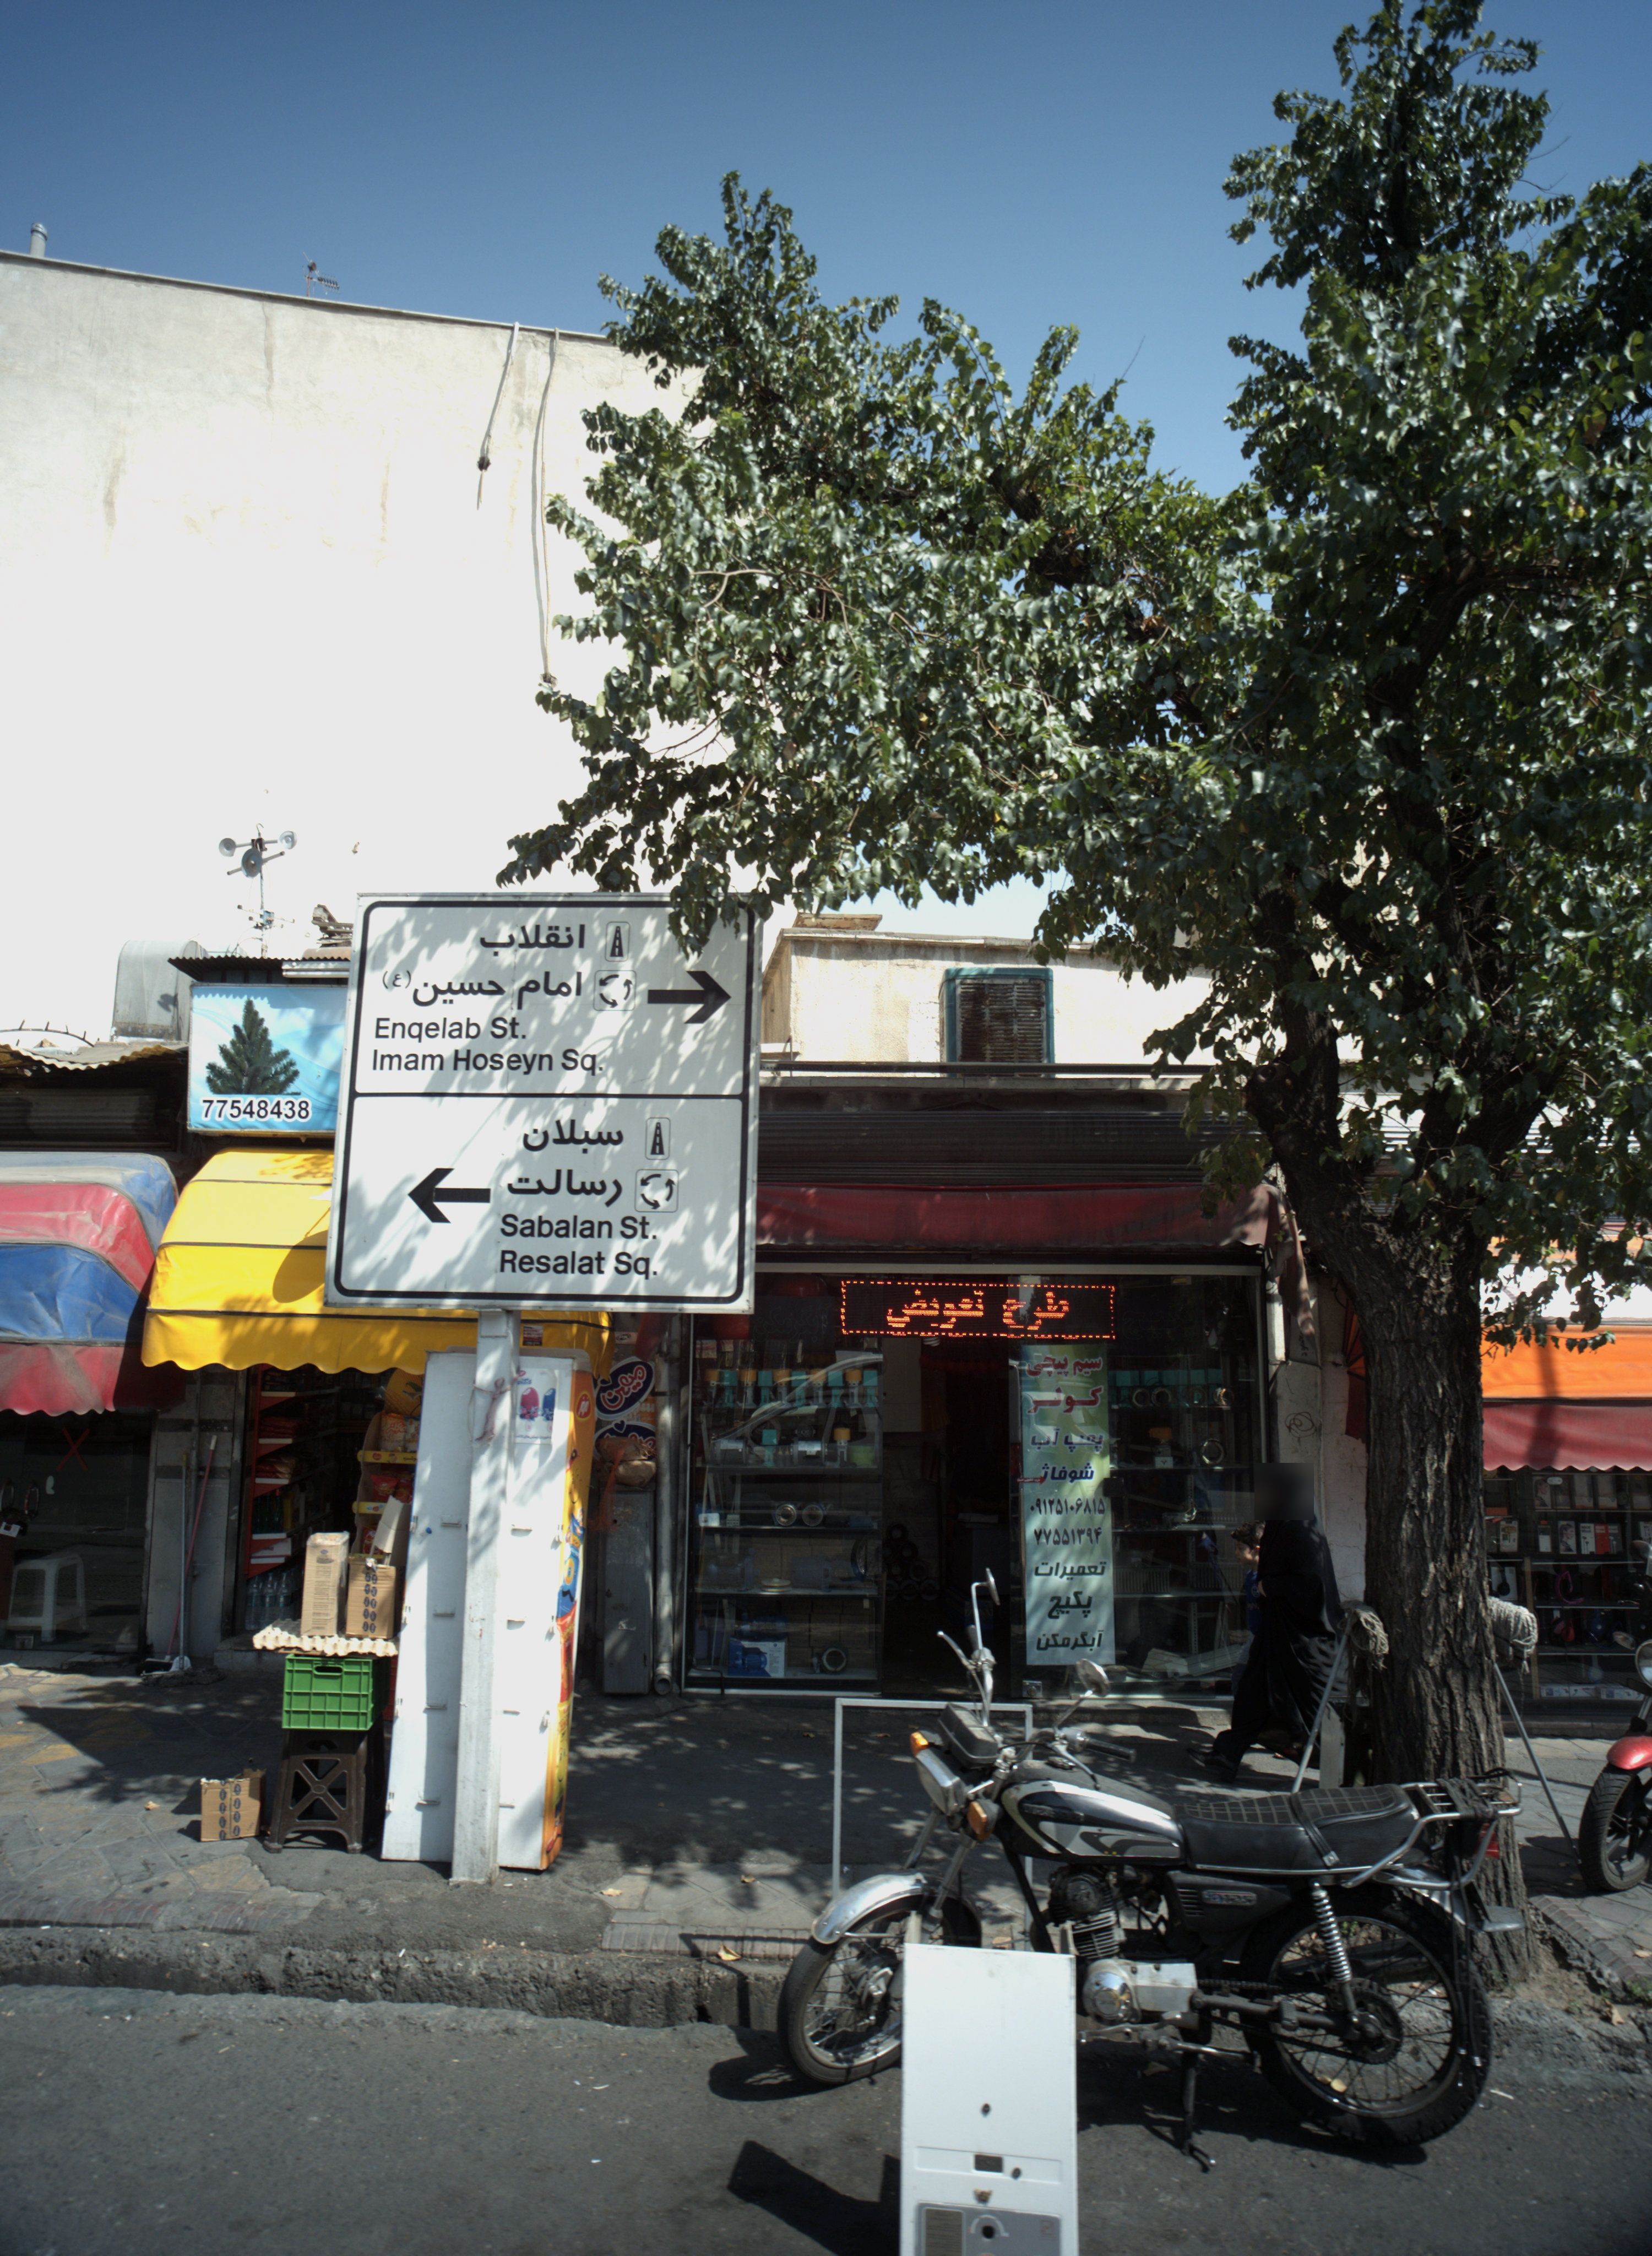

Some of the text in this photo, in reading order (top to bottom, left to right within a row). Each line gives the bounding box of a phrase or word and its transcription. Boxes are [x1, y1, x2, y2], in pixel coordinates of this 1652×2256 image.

[480, 924, 586, 957] انقلاب
[517, 971, 583, 1010] امام
[375, 1017, 526, 1043] Enqelab St.
[372, 1049, 604, 1076] Imam Hoseyn Sq.
[202, 1099, 310, 1120] 77548438
[522, 1119, 623, 1153] سبلان
[507, 1169, 623, 1207] رسالت
[500, 1214, 657, 1240] Sabalan St.
[499, 1250, 658, 1280] Resalat Sq.
[1003, 1291, 1069, 1330] طرح
[1026, 1355, 1102, 1377] سیم پیچی
[601, 1365, 646, 1410] میهن
[1027, 1386, 1104, 1414] کولر
[1030, 1428, 1104, 1453] پمپ آب
[1041, 1462, 1095, 1483] شوفاژ
[1034, 1527, 1102, 1545] ۷۷۵۵۱۳۹۴
[1034, 1561, 1107, 1581] تعمیرات
[1047, 1590, 1093, 1619] پکیج
[1036, 1629, 1104, 1652] آبگرمکن
